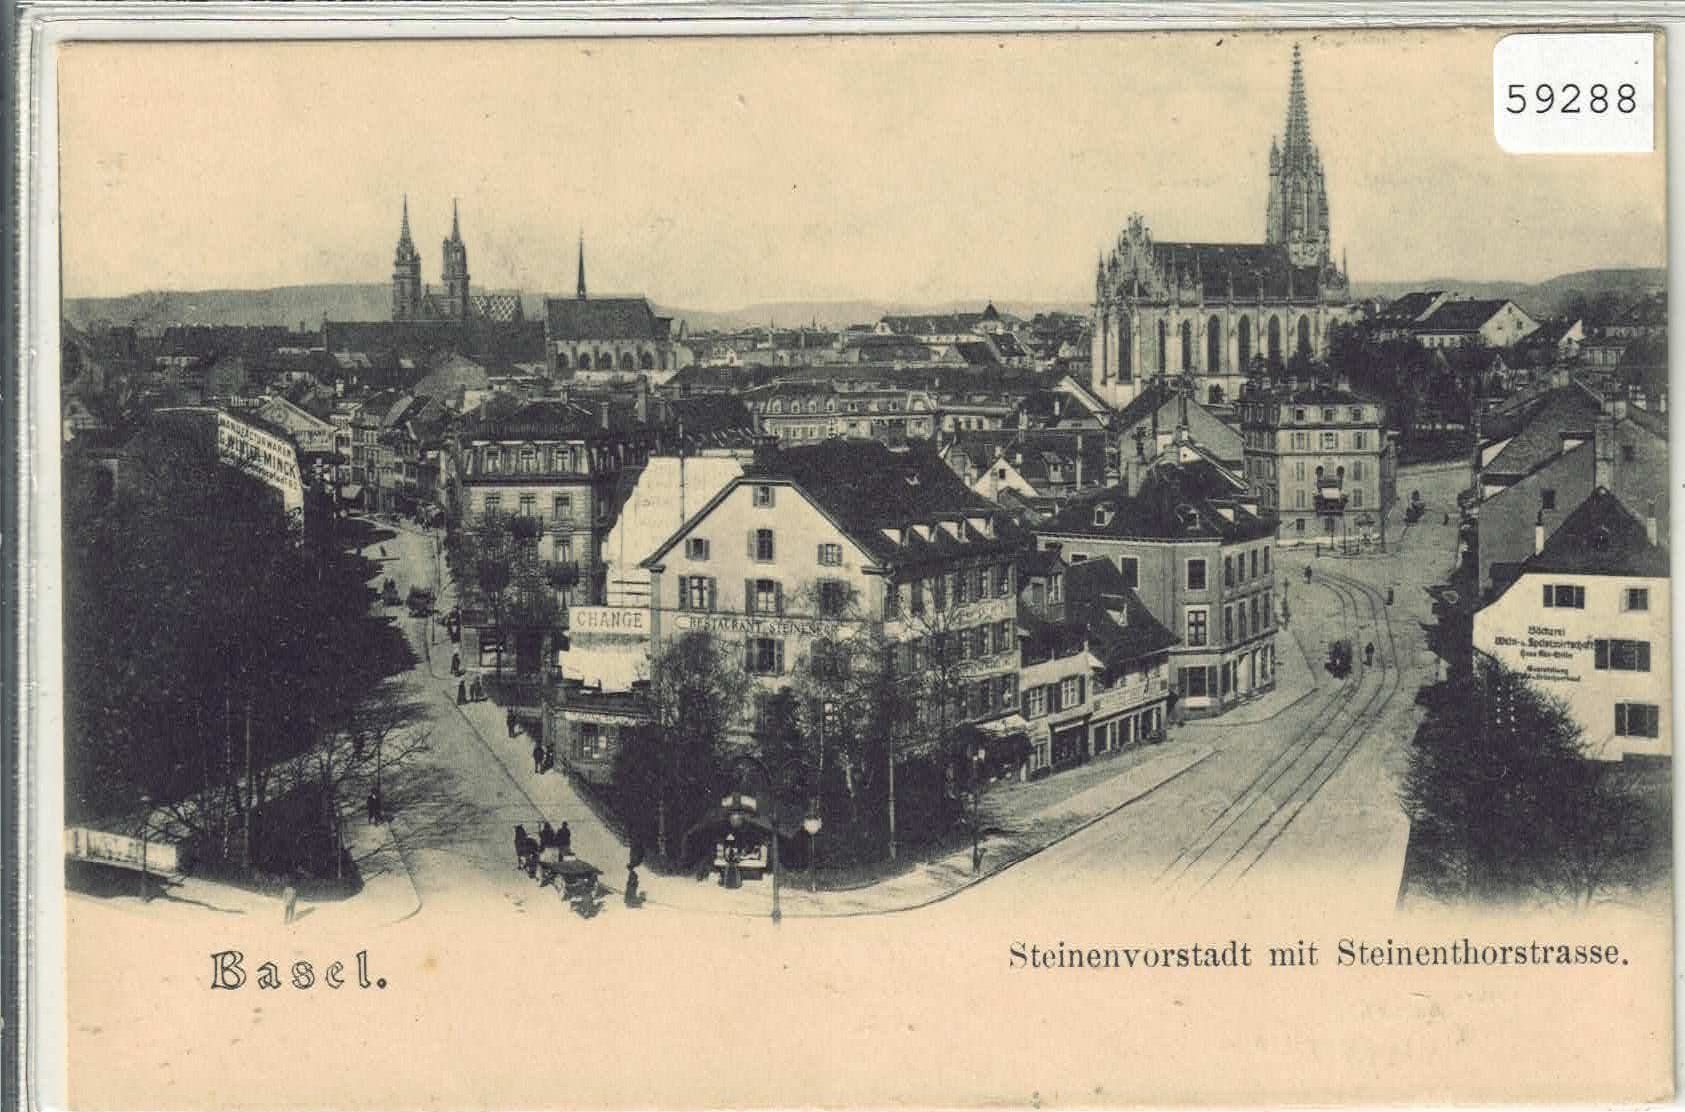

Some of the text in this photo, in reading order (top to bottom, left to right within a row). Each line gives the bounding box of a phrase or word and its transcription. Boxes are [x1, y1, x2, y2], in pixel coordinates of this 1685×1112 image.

[1506, 83, 1637, 114] 59288
[577, 611, 642, 628] CHANGE
[689, 615, 762, 633] RESTAURANT
